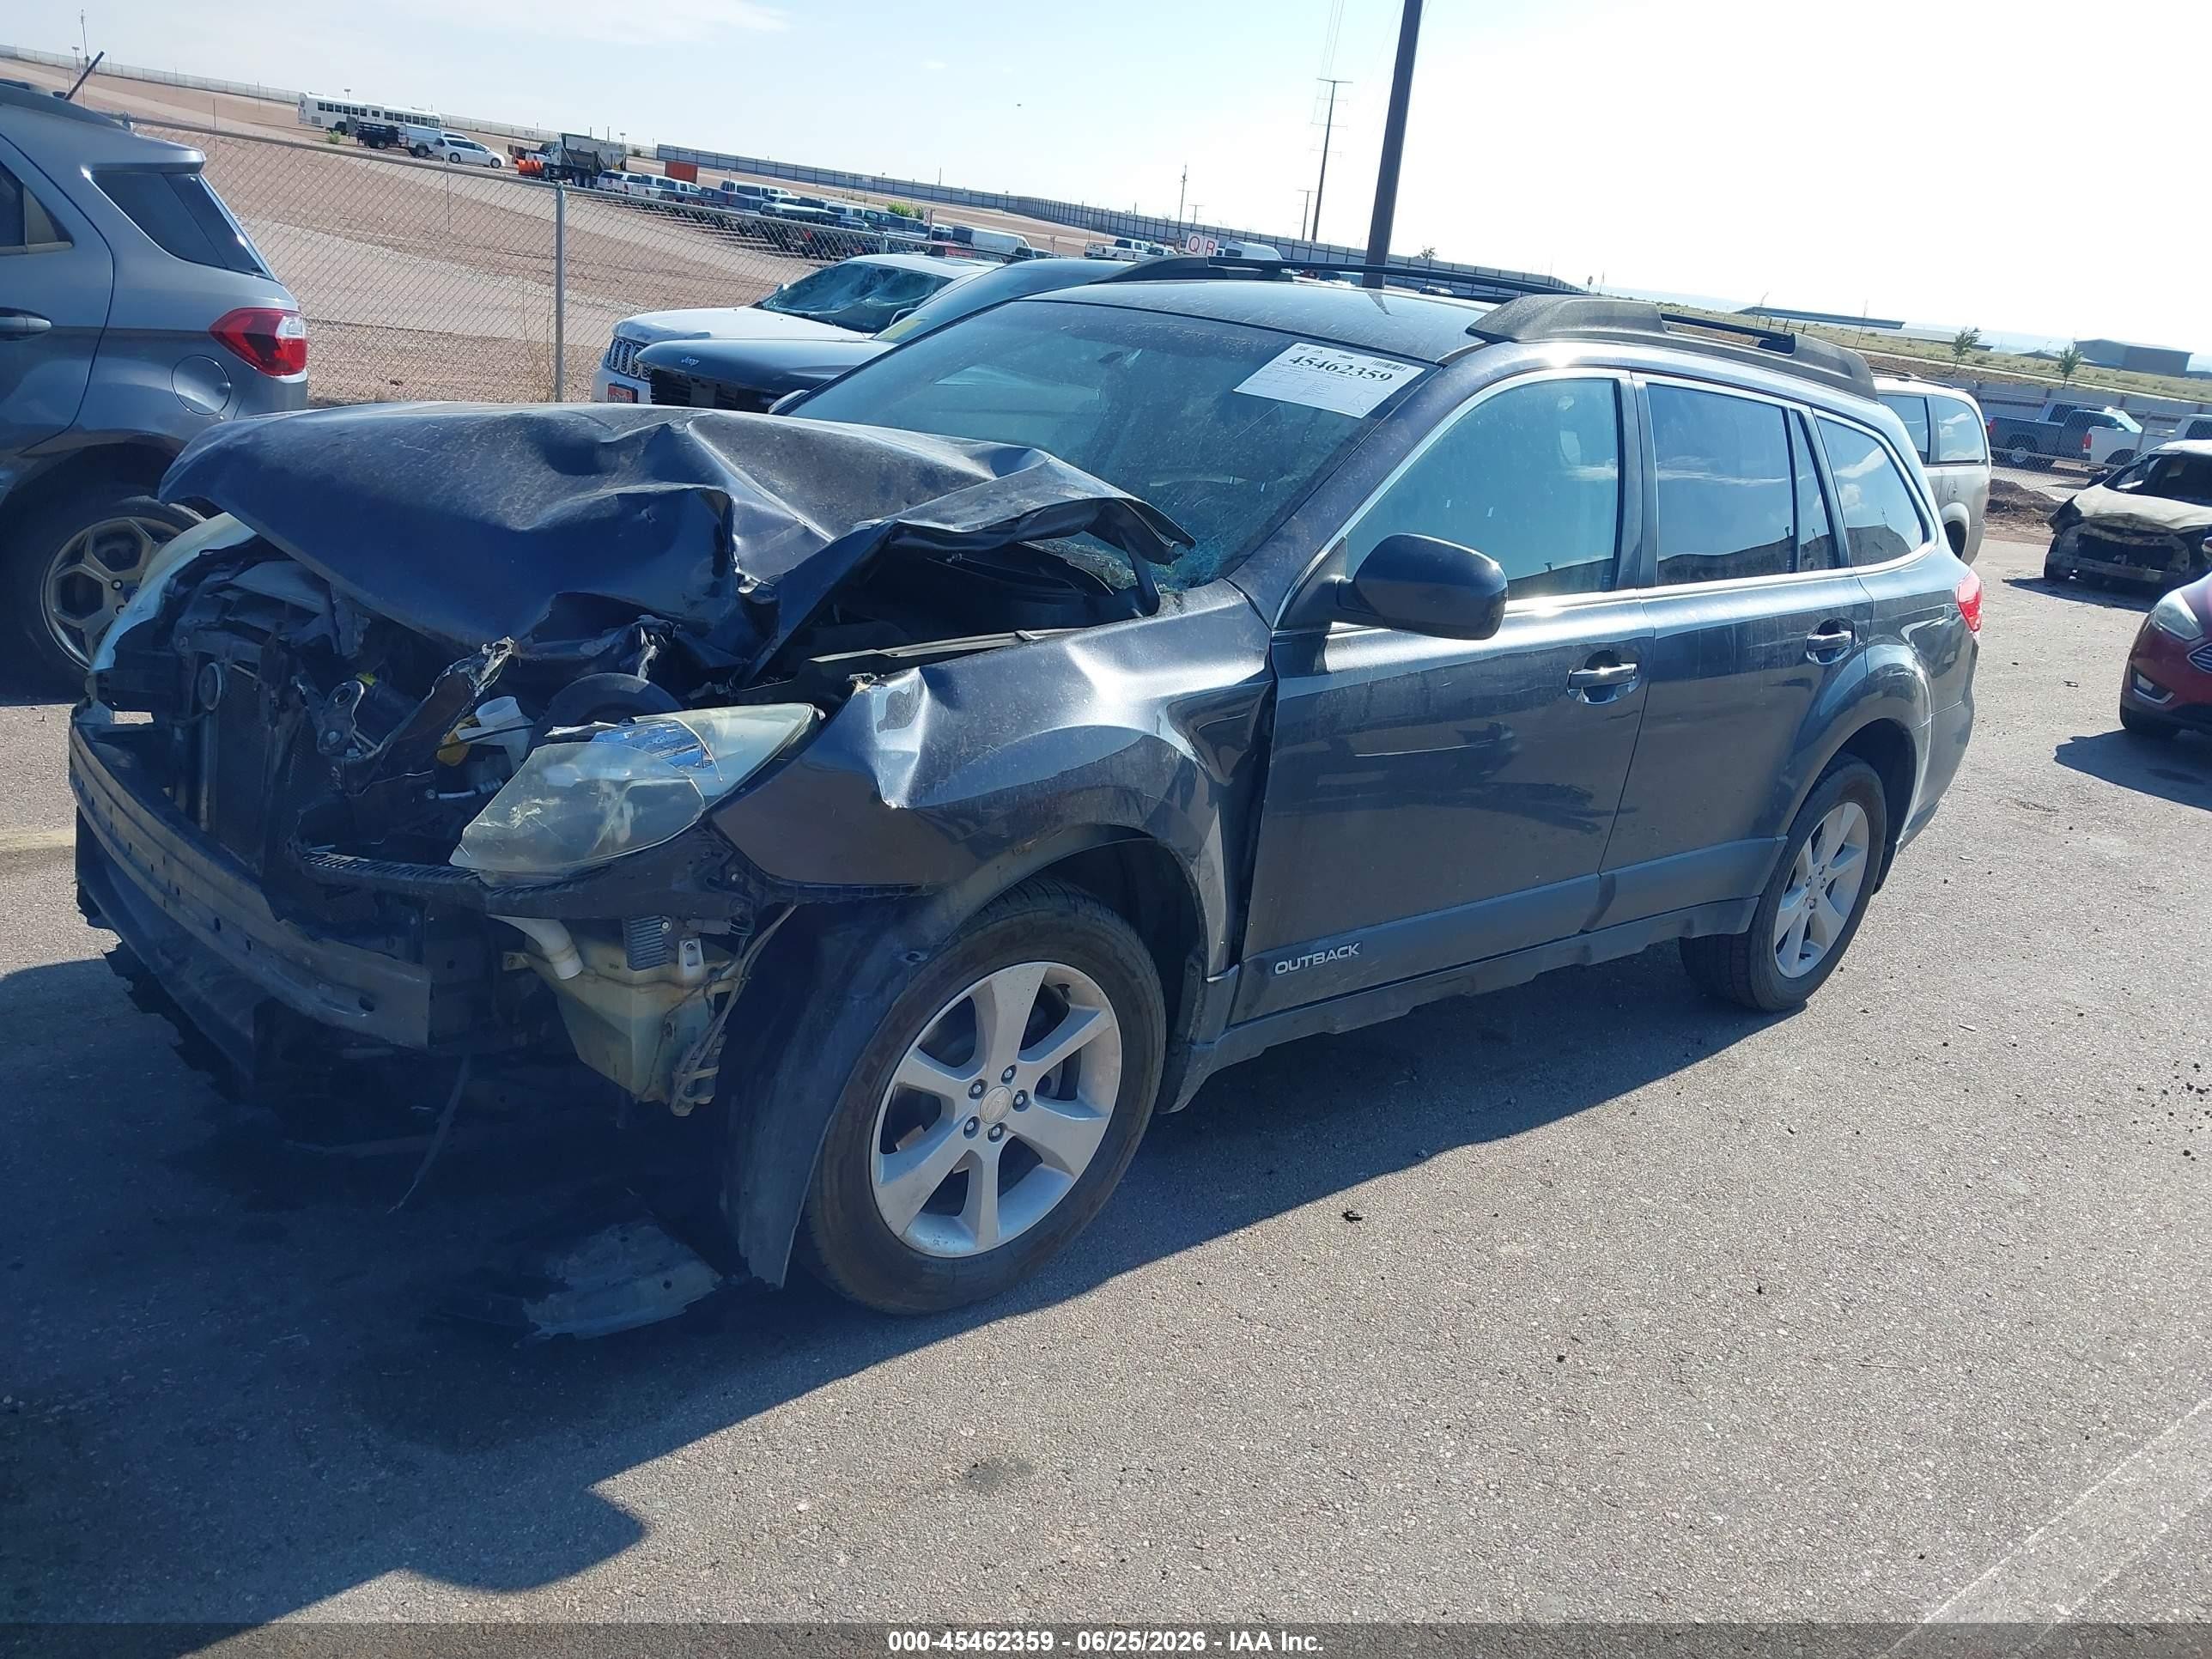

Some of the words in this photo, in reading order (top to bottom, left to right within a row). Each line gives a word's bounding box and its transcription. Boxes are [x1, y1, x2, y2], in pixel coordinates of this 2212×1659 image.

[1189, 235, 1200, 253] Q
[1205, 240, 1215, 256] R
[1289, 355, 1393, 382] 45462359
[1274, 942, 1361, 975] OUTBACK
